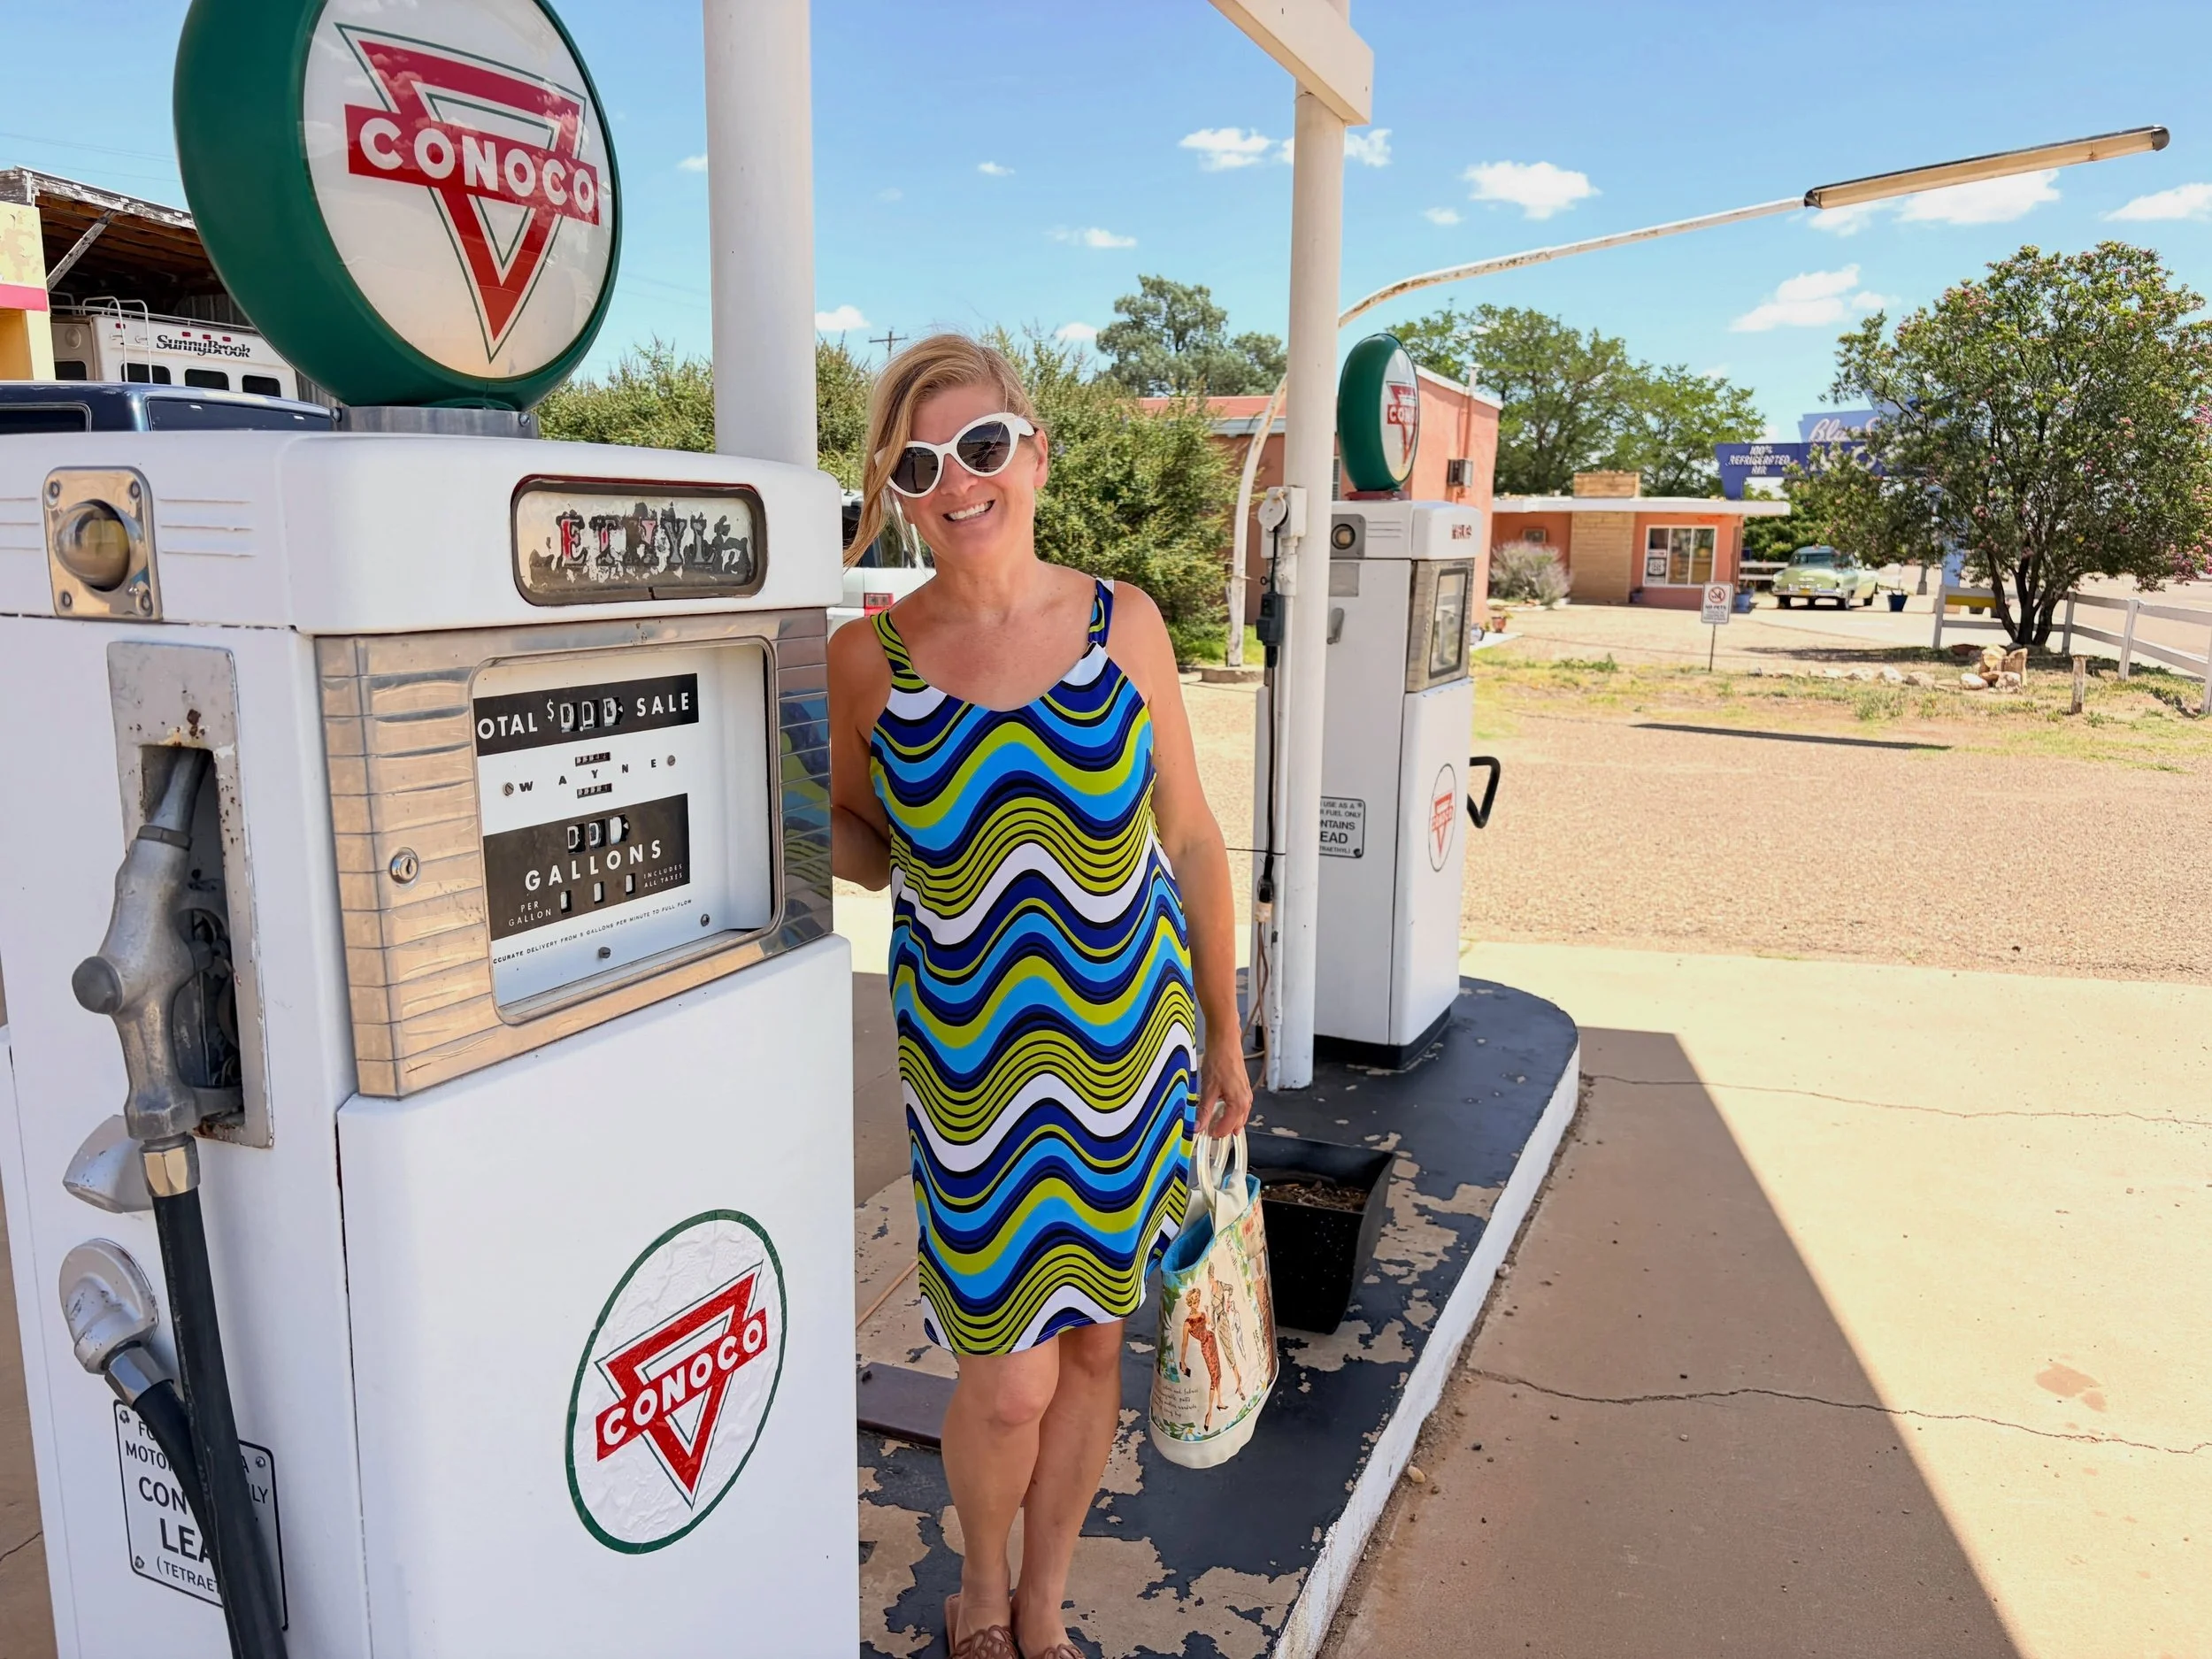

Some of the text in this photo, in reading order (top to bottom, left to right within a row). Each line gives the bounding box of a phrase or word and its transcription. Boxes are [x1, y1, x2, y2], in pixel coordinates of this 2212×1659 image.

[359, 118, 595, 213] CONOCO
[157, 334, 250, 357] SunnyBrook
[1749, 445, 1772, 455] 100%
[1729, 454, 1791, 465] REFRIGERATED
[1751, 465, 1767, 475] AIR
[477, 711, 538, 740] OTAL
[636, 692, 689, 717] SALE
[1320, 819, 1356, 831] NTAINS
[1320, 831, 1348, 844] EAD
[525, 839, 662, 891] GALLONS
[643, 864, 683, 879] INCLUDES
[644, 872, 683, 887] ALL TAXES
[520, 901, 539, 912] PER
[509, 909, 551, 926] GALLON
[493, 950, 524, 964] CCURATE
[526, 941, 557, 954] DELIVERY
[586, 924, 613, 934] GALLONS
[629, 911, 650, 921] MINUTE
[603, 1319, 763, 1446] CONOCO
[125, 1440, 173, 1472] MOTO
[159, 1517, 214, 1563] LEA
